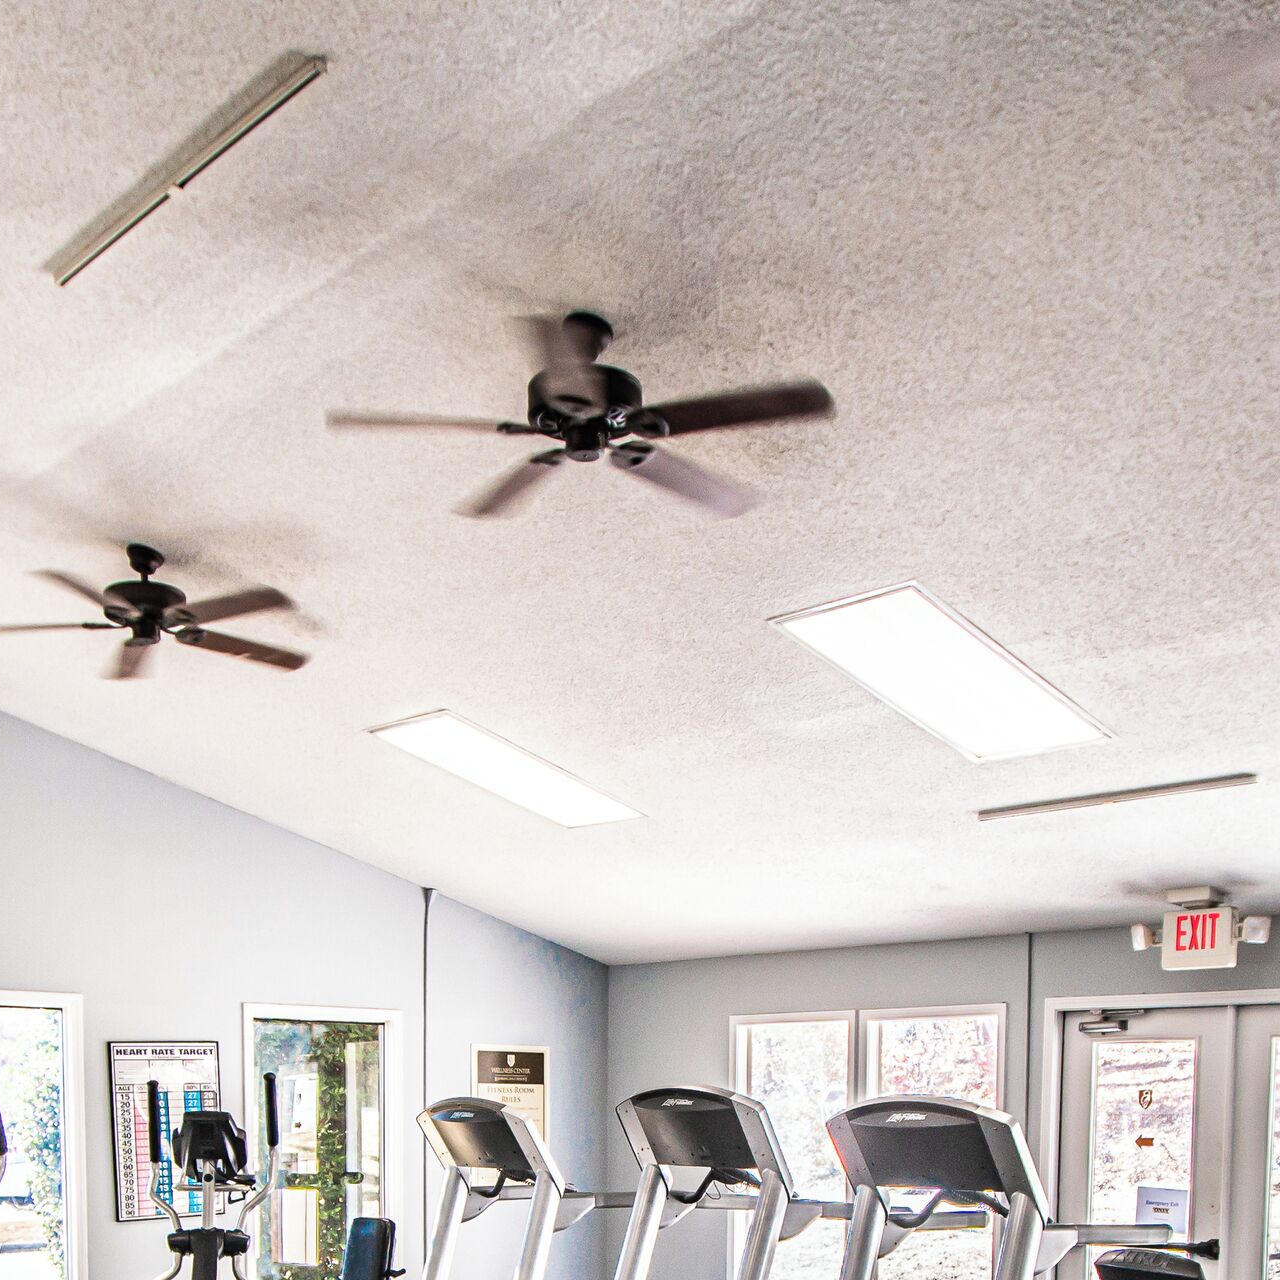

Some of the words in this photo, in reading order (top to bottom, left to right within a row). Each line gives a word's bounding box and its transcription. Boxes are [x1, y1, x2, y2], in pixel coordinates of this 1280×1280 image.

[1175, 912, 1221, 951] EXIT
[115, 1048, 148, 1056] HEART
[151, 1048, 176, 1056] RATE
[179, 1048, 214, 1056] TARGET
[487, 1086, 513, 1094] FITNESS
[514, 1086, 535, 1094] ROOM
